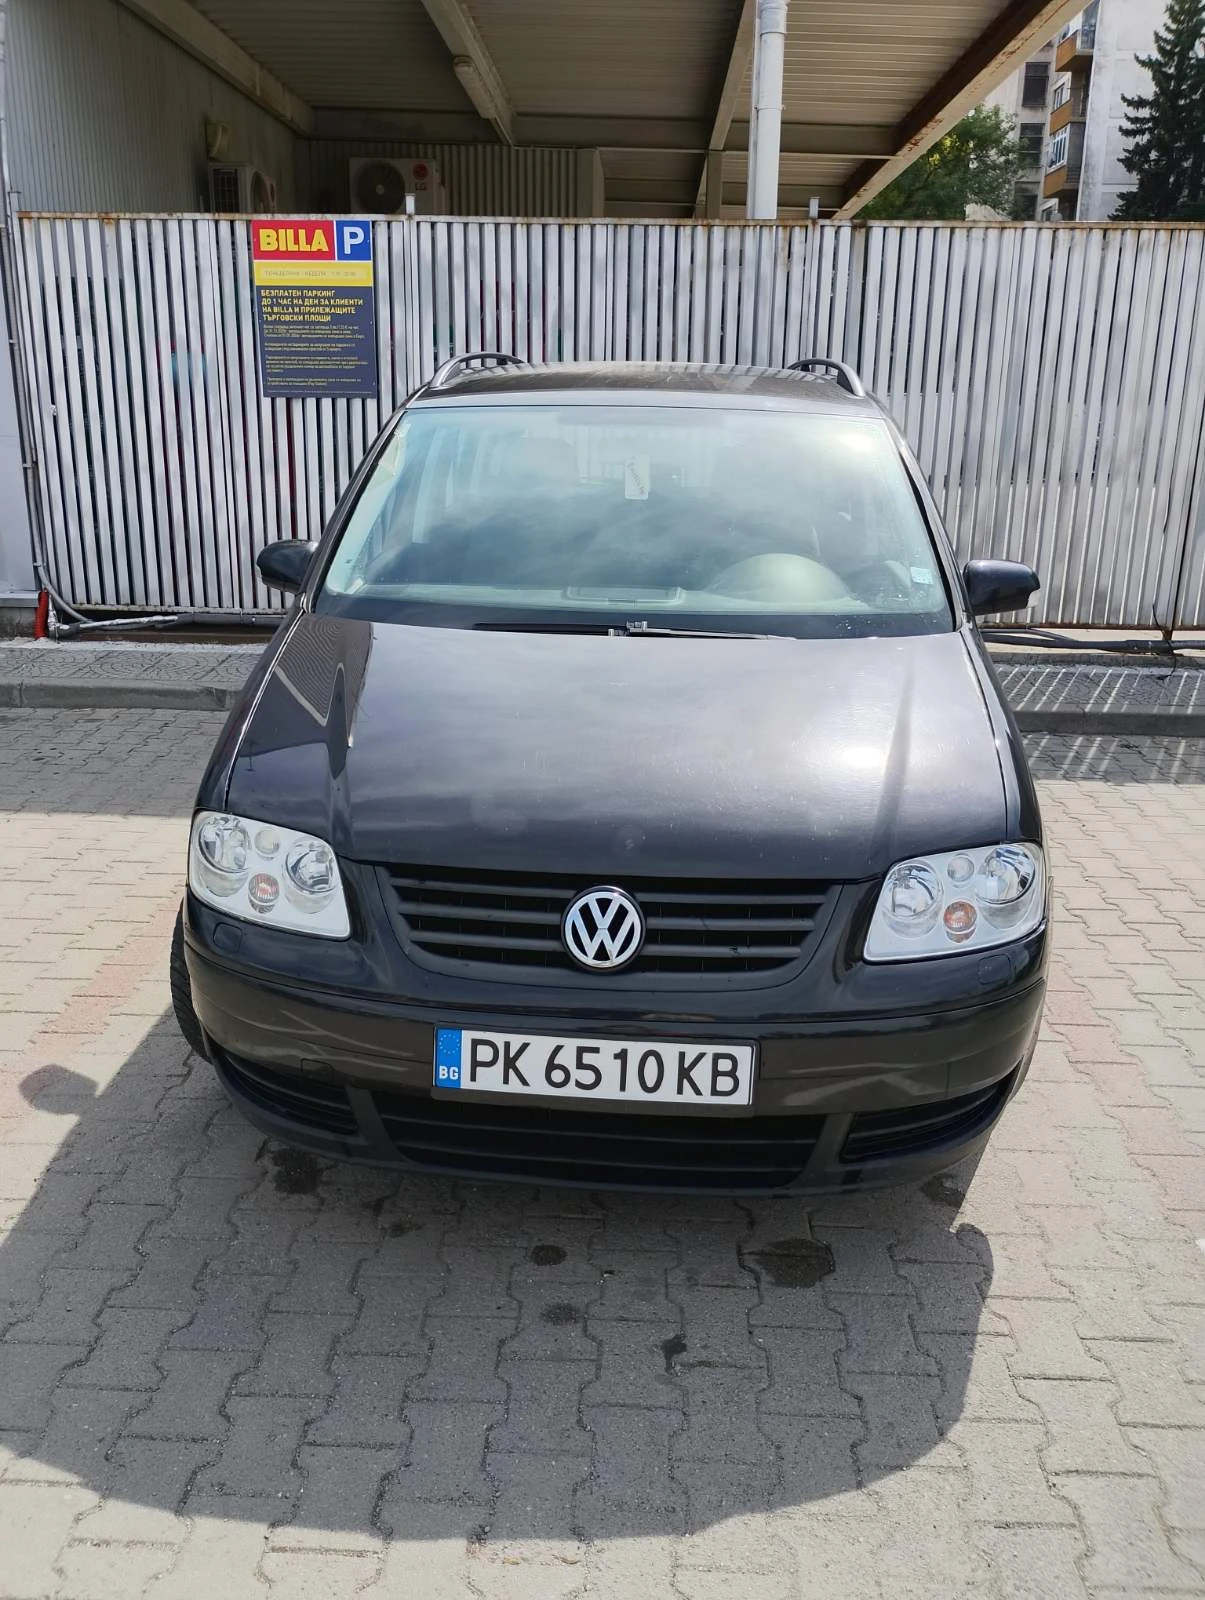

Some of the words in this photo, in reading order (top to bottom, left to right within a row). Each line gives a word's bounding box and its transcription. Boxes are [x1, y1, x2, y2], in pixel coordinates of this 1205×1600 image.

[259, 228, 329, 252] BILLA
[343, 226, 365, 254] P
[261, 289, 302, 297] БЕЗПЛАТЕН
[303, 289, 335, 297] ПАРКИНГ
[304, 298, 320, 306] ДЕН
[320, 298, 330, 306] ЗА
[330, 298, 364, 306] КЛИЕНТИ
[301, 306, 356, 314] ПРИЛЕЖАЩИТЕ
[263, 314, 303, 322] ТЪРГОВСКИ
[564, 891, 642, 968] VW
[438, 1065, 459, 1080] BG
[469, 1038, 531, 1087] PK
[544, 1044, 665, 1094] 6510
[676, 1050, 740, 1097] KB
